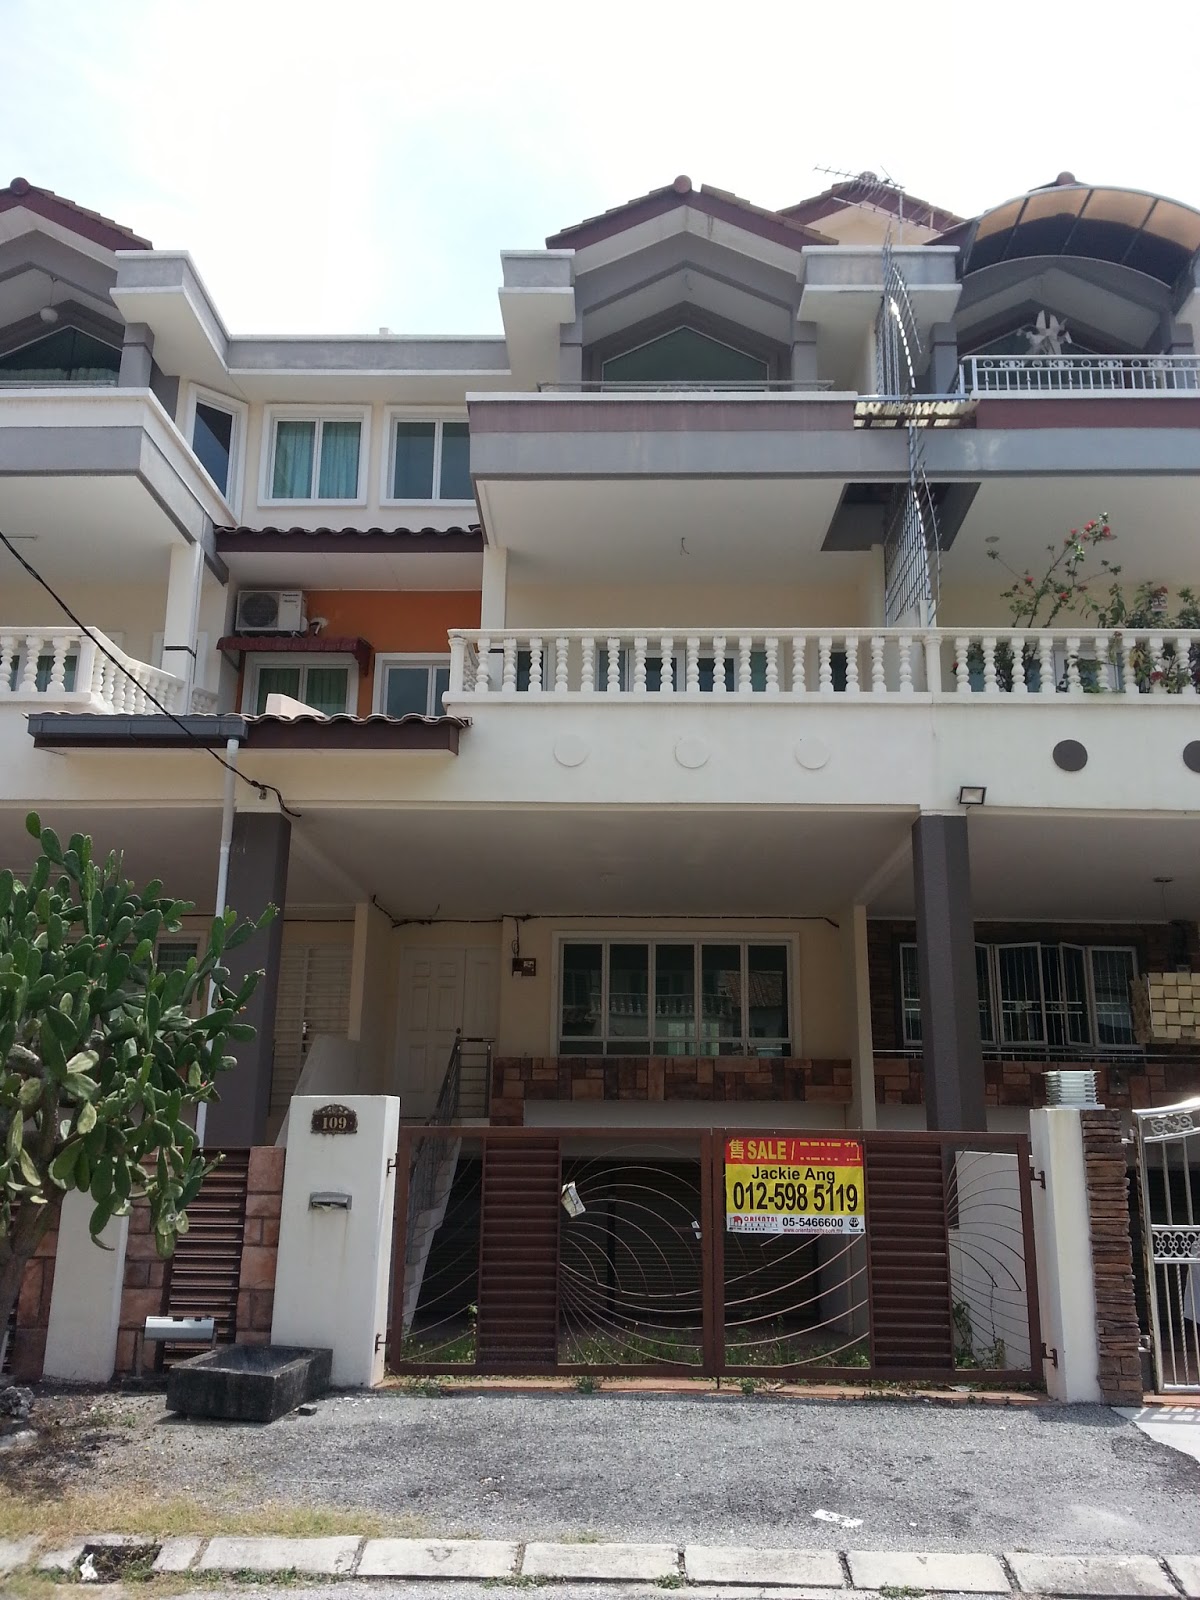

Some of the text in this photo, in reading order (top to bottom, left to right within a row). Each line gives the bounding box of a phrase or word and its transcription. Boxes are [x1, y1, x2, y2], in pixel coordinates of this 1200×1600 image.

[322, 1117, 347, 1129] 109
[729, 1140, 744, 1159] 售
[748, 1141, 786, 1160] SALE
[752, 1167, 835, 1184] Jackie Ang
[733, 1182, 858, 1211] 012-598 5119
[782, 1217, 844, 1227] 05-5466600
